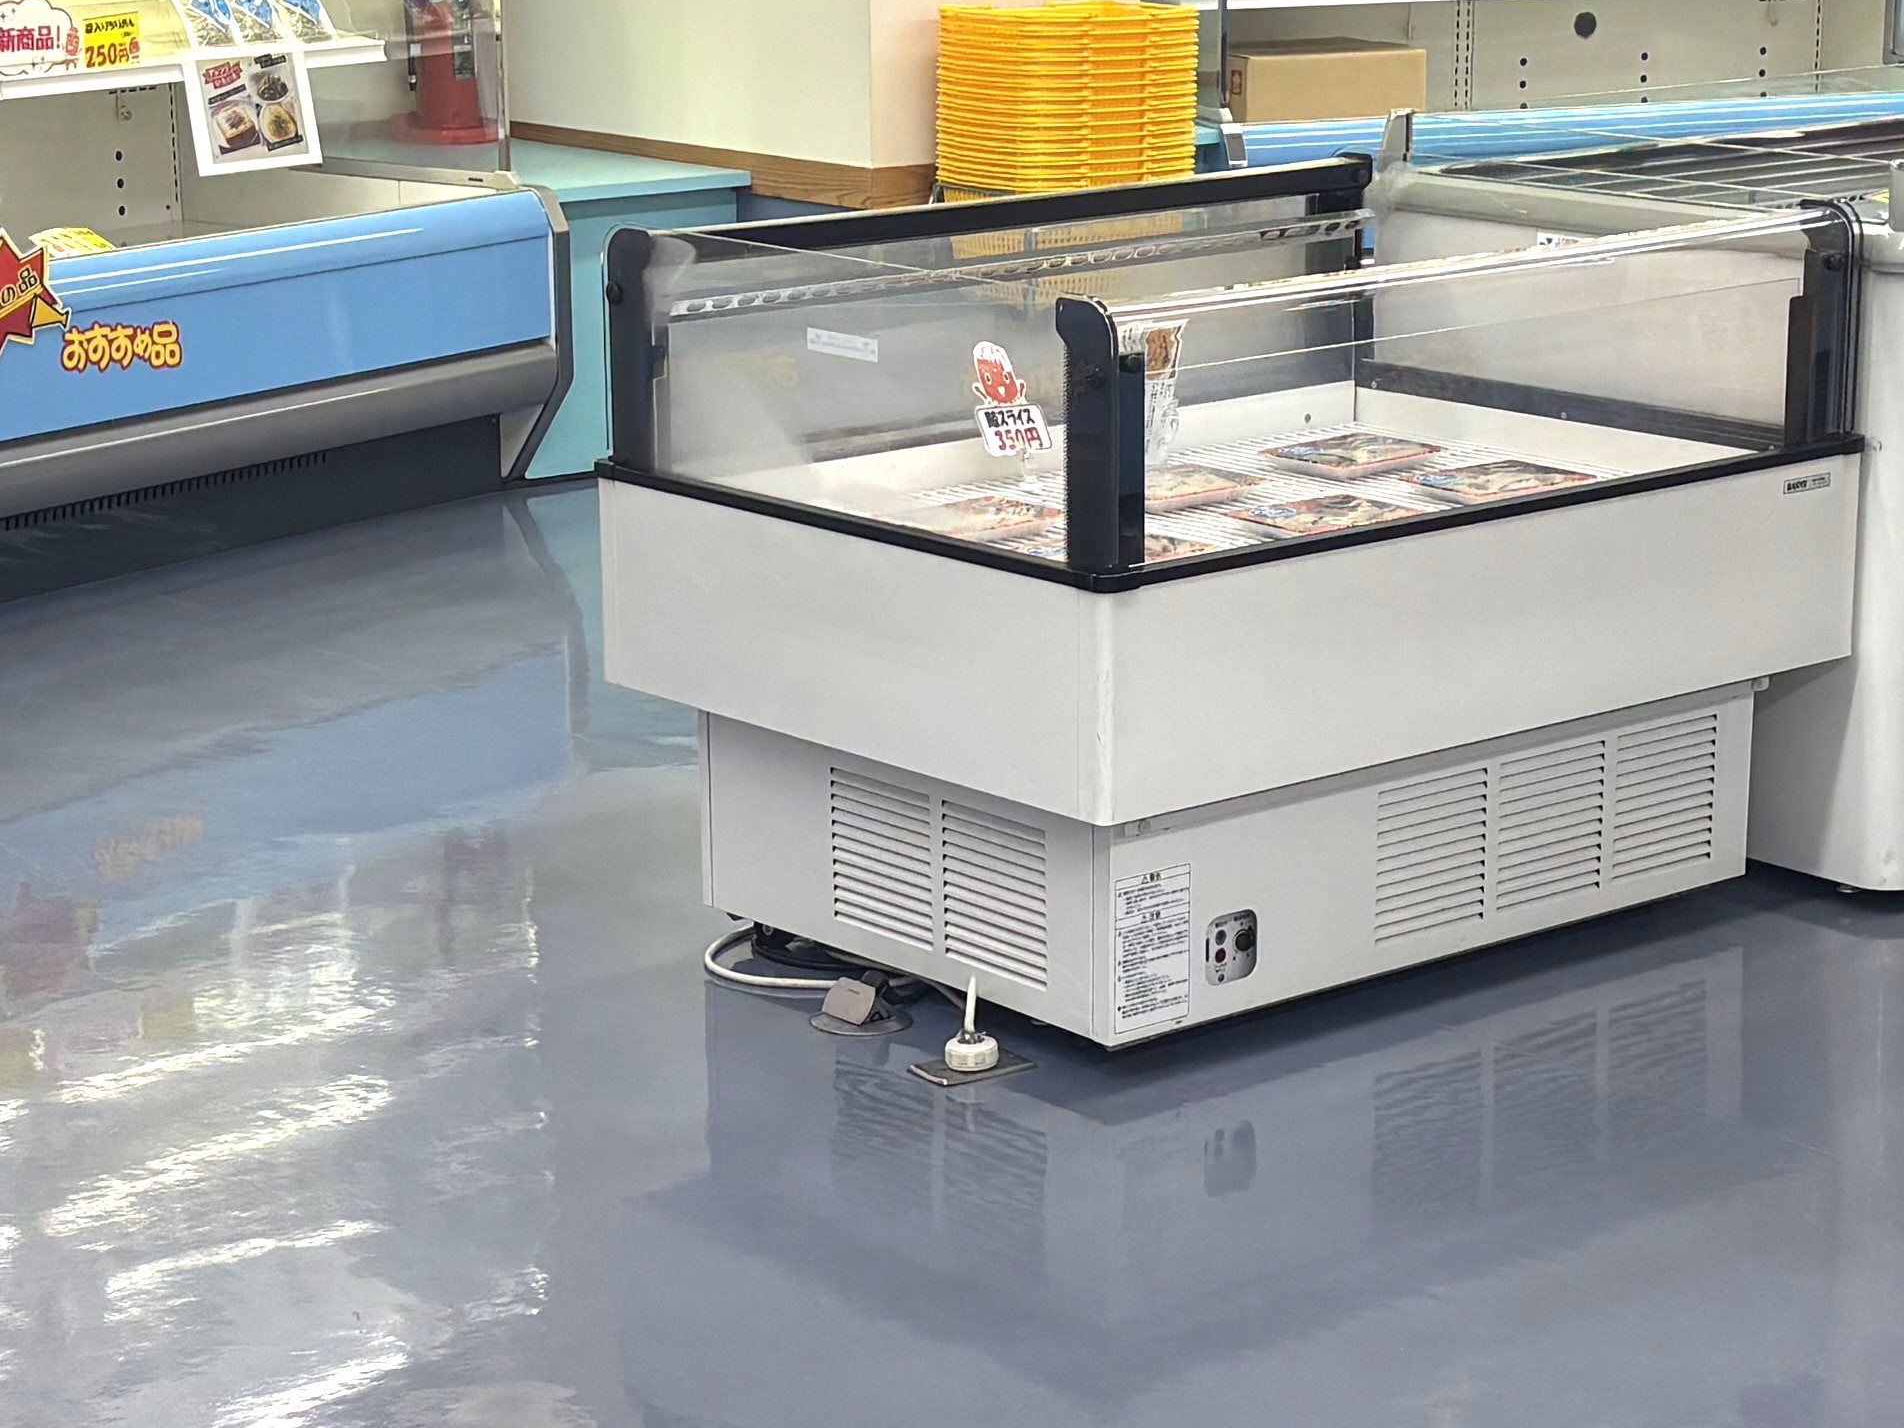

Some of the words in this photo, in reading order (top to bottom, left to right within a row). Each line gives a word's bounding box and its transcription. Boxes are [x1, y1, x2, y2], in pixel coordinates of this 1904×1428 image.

[84, 41, 130, 69] 250円
[60, 321, 182, 373] おすすめ品
[994, 426, 1044, 451] 350円
